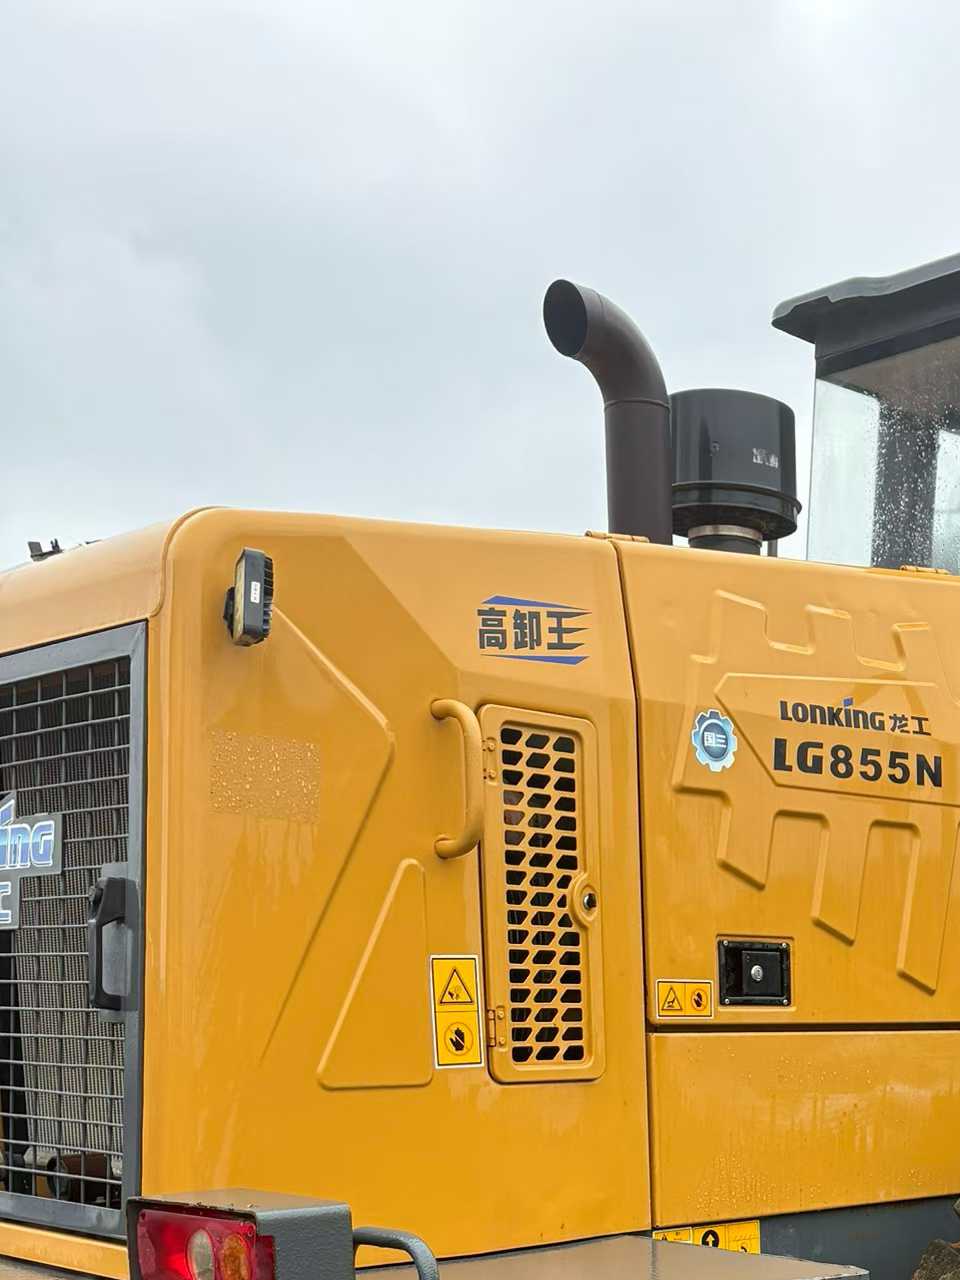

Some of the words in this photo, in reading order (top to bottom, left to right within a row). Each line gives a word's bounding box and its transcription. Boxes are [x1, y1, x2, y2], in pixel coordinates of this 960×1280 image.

[477, 607, 592, 650] 高卸王
[889, 713, 932, 736] 龙工
[773, 737, 943, 788] LG855N
